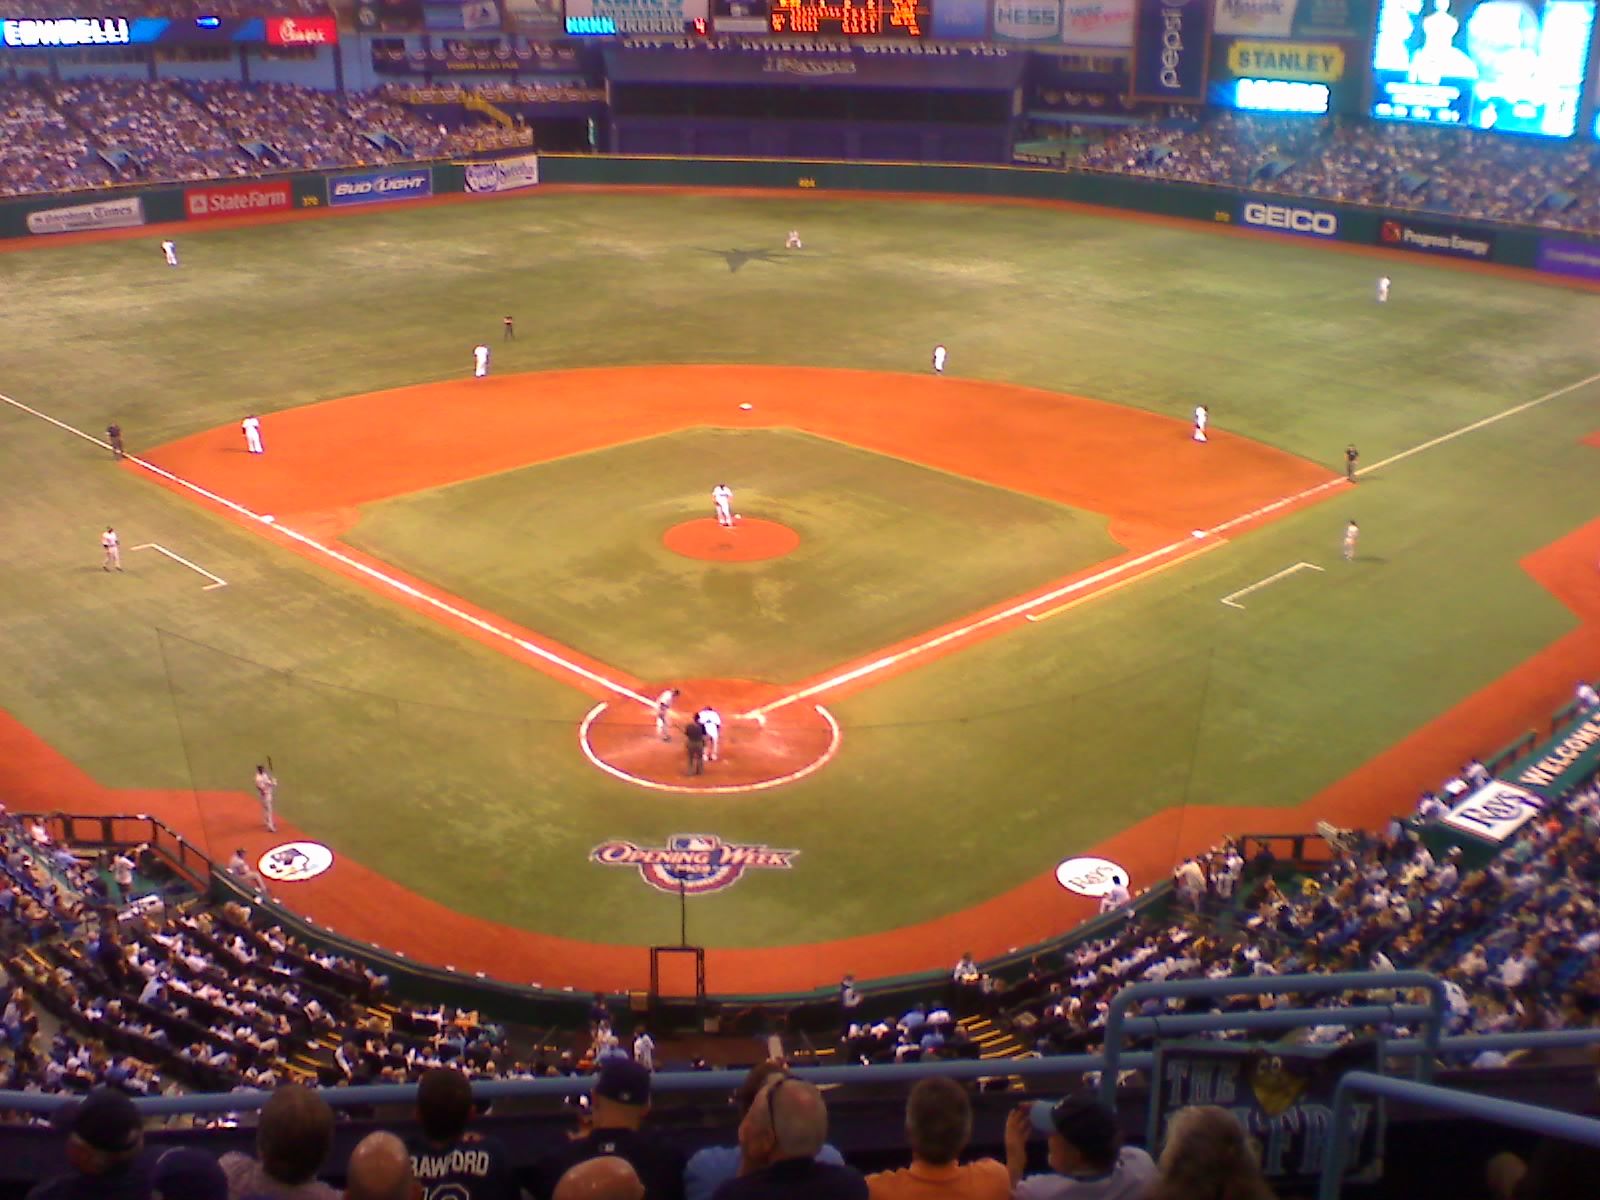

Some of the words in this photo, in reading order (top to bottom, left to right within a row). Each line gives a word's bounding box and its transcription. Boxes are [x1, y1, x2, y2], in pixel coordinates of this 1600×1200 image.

[997, 7, 1057, 25] HESS
[1238, 50, 1335, 73] STANLEY
[334, 183, 372, 197] BUD
[377, 177, 425, 193] LIGHT
[1244, 203, 1338, 235] GEICO
[1519, 712, 1600, 786] WELCOM
[600, 842, 711, 864] OPENING
[720, 844, 788, 865] WEEK
[410, 1148, 490, 1178] RAWFORD
